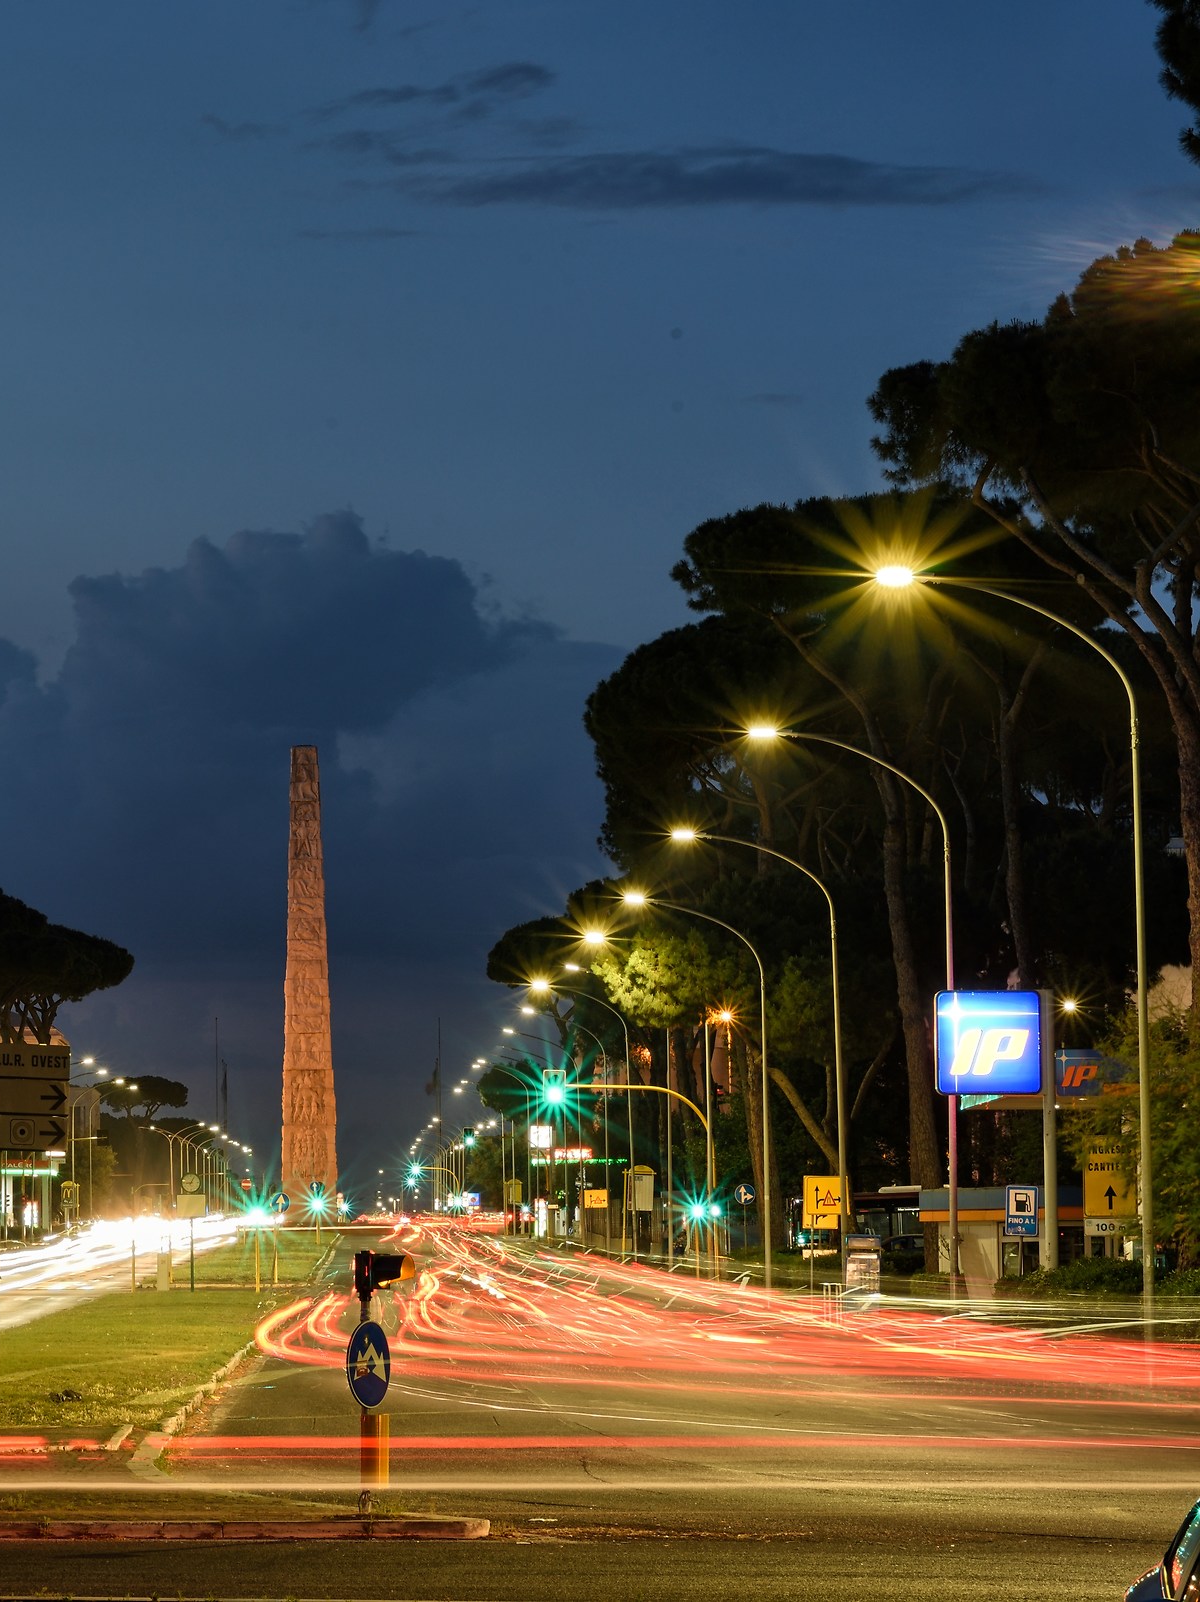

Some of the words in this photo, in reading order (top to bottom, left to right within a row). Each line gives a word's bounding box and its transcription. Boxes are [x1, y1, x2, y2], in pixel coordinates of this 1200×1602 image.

[949, 1028, 1030, 1076] IP
[31, 1055, 68, 1069] OVEST
[1061, 1065, 1099, 1088] IP
[1088, 1162, 1120, 1172] CANTIE
